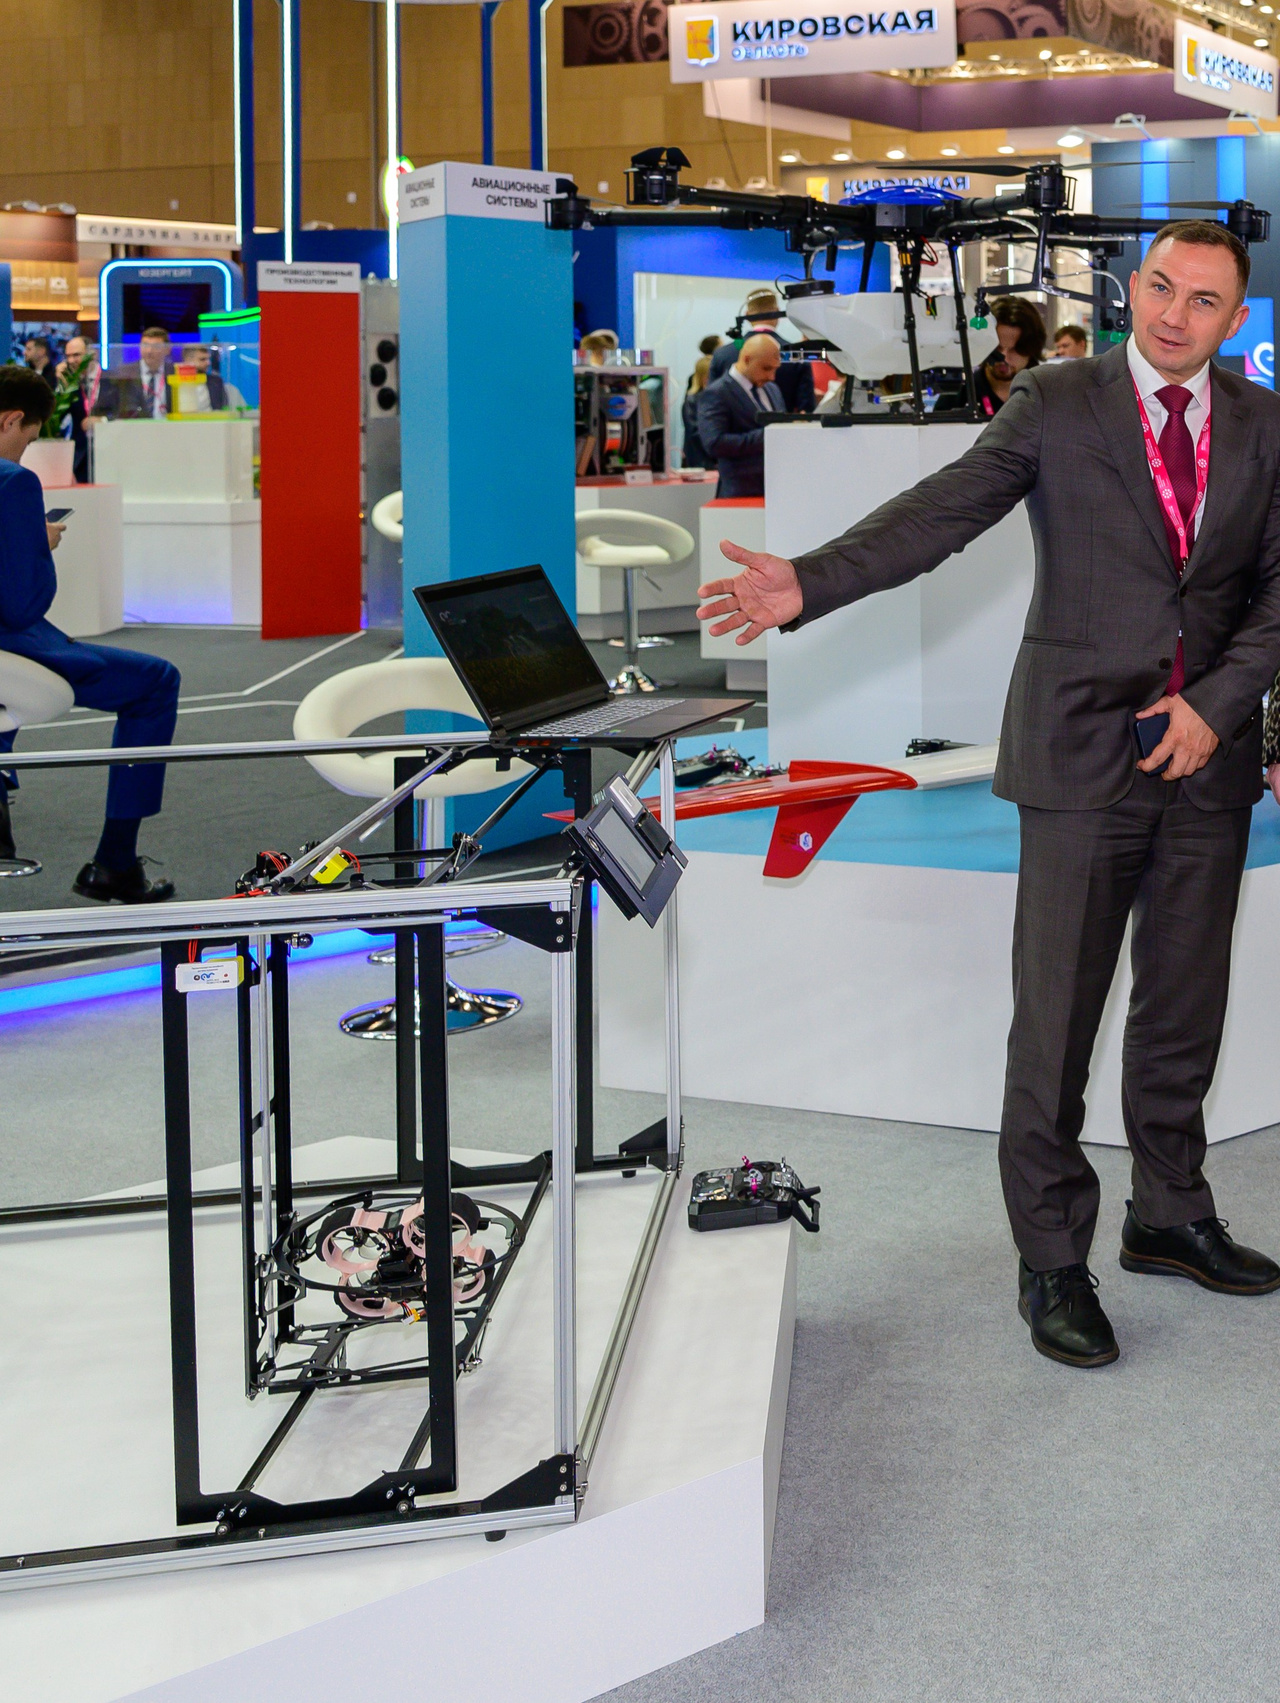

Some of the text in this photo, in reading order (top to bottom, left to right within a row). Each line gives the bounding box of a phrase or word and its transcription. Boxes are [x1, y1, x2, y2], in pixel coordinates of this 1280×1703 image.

[732, 8, 938, 43] КИРОВСКАЯ
[471, 177, 551, 195] АВИАЦИОННЫЕ
[485, 194, 538, 209] СИСТЕМЫ
[265, 268, 353, 276] ПРОИЗВОДСТВЕННЫЕ
